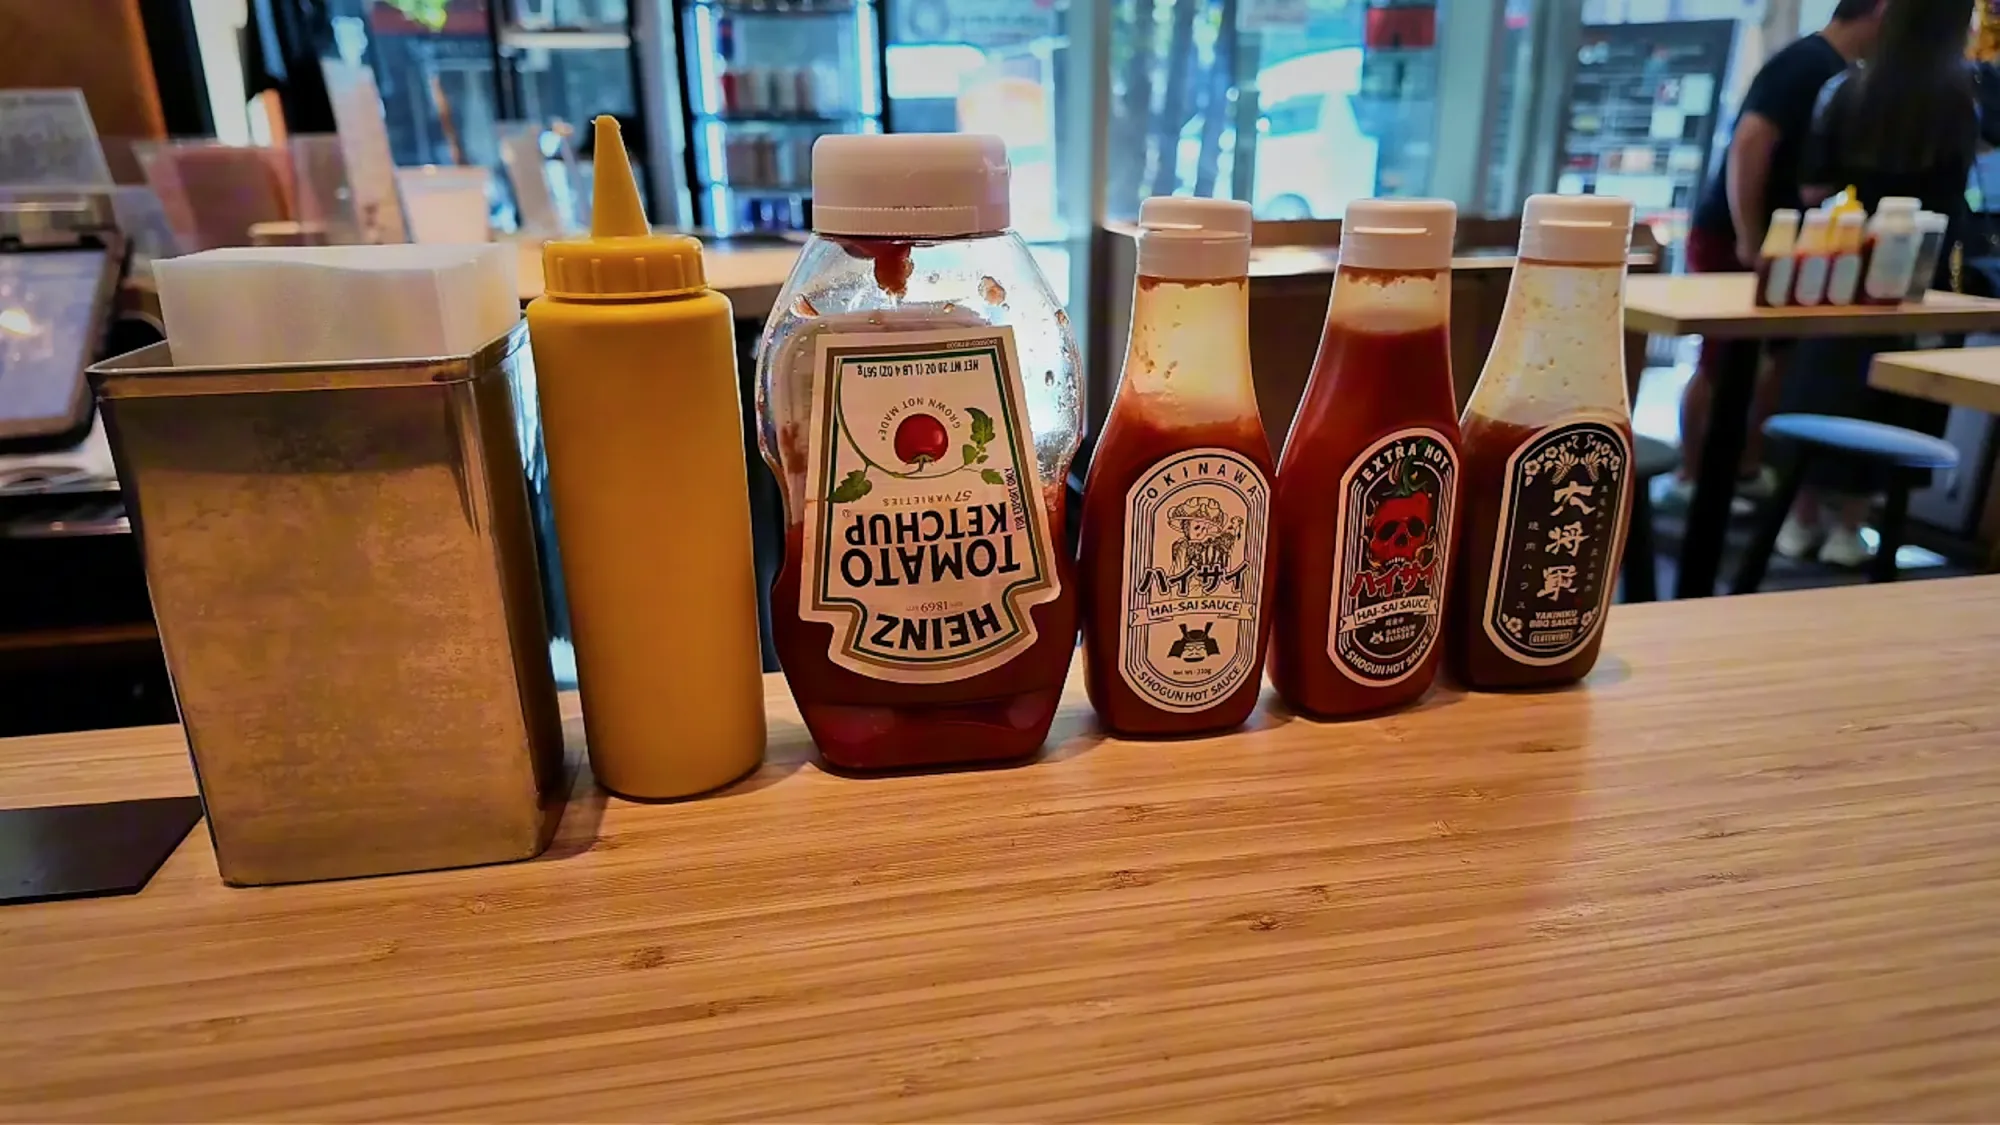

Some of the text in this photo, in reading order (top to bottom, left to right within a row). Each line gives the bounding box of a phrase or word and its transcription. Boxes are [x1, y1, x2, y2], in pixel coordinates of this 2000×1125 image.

[902, 364, 913, 376] LB
[925, 363, 936, 374] OZ
[937, 362, 948, 373] 20
[950, 360, 963, 373] WT
[964, 359, 979, 372] NET
[901, 397, 924, 409] NOT
[928, 398, 961, 429] GROWN
[1362, 442, 1449, 482] EXTRA HOT
[1147, 462, 1258, 500] OKINAWA
[882, 490, 973, 507] 57 VARIETIES
[845, 504, 1008, 546] KETCHUP
[1536, 480, 1597, 602] 大将軍
[840, 534, 1021, 588] TOMATO
[1136, 561, 1250, 596] ハイサイ
[1348, 556, 1440, 598] ハイサイ
[920, 600, 948, 612] 1869
[1150, 599, 1240, 617] HAI-SAI SAUCE
[1355, 602, 1400, 622] HAI-SAI
[1400, 599, 1429, 613] SAUCE
[1535, 610, 1578, 620] YAKINIKU
[870, 602, 1002, 651] HEINZ
[1529, 617, 1579, 628] BBQ SAUCE
[1345, 635, 1431, 676] SHOGUN HOT SAUCE
[1138, 665, 1242, 702] SHOGUN HOT SAUCE
